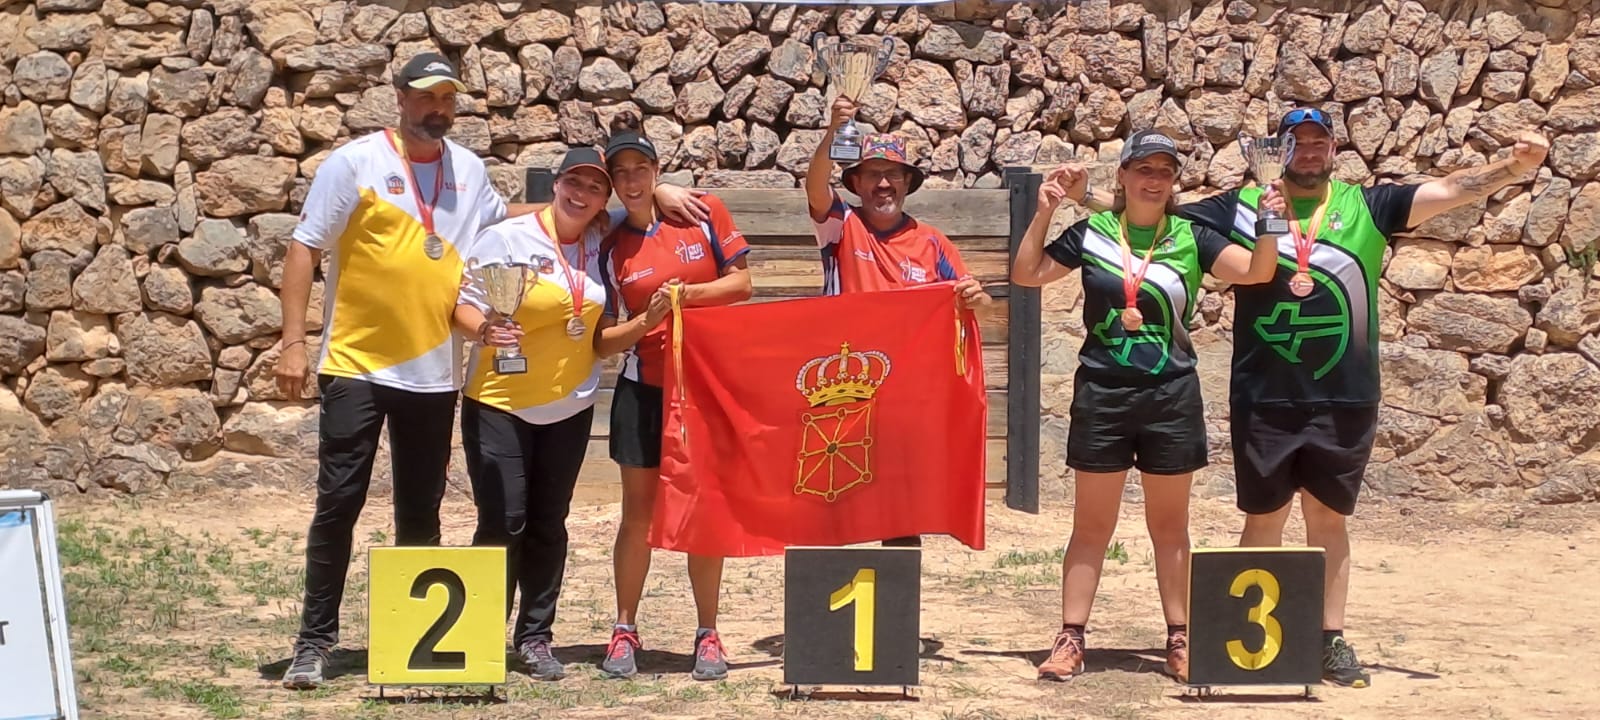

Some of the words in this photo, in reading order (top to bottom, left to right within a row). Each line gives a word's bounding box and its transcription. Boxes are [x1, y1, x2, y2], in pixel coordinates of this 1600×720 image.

[408, 568, 466, 670] 2
[830, 569, 876, 672] 1
[1226, 569, 1282, 670] 3
